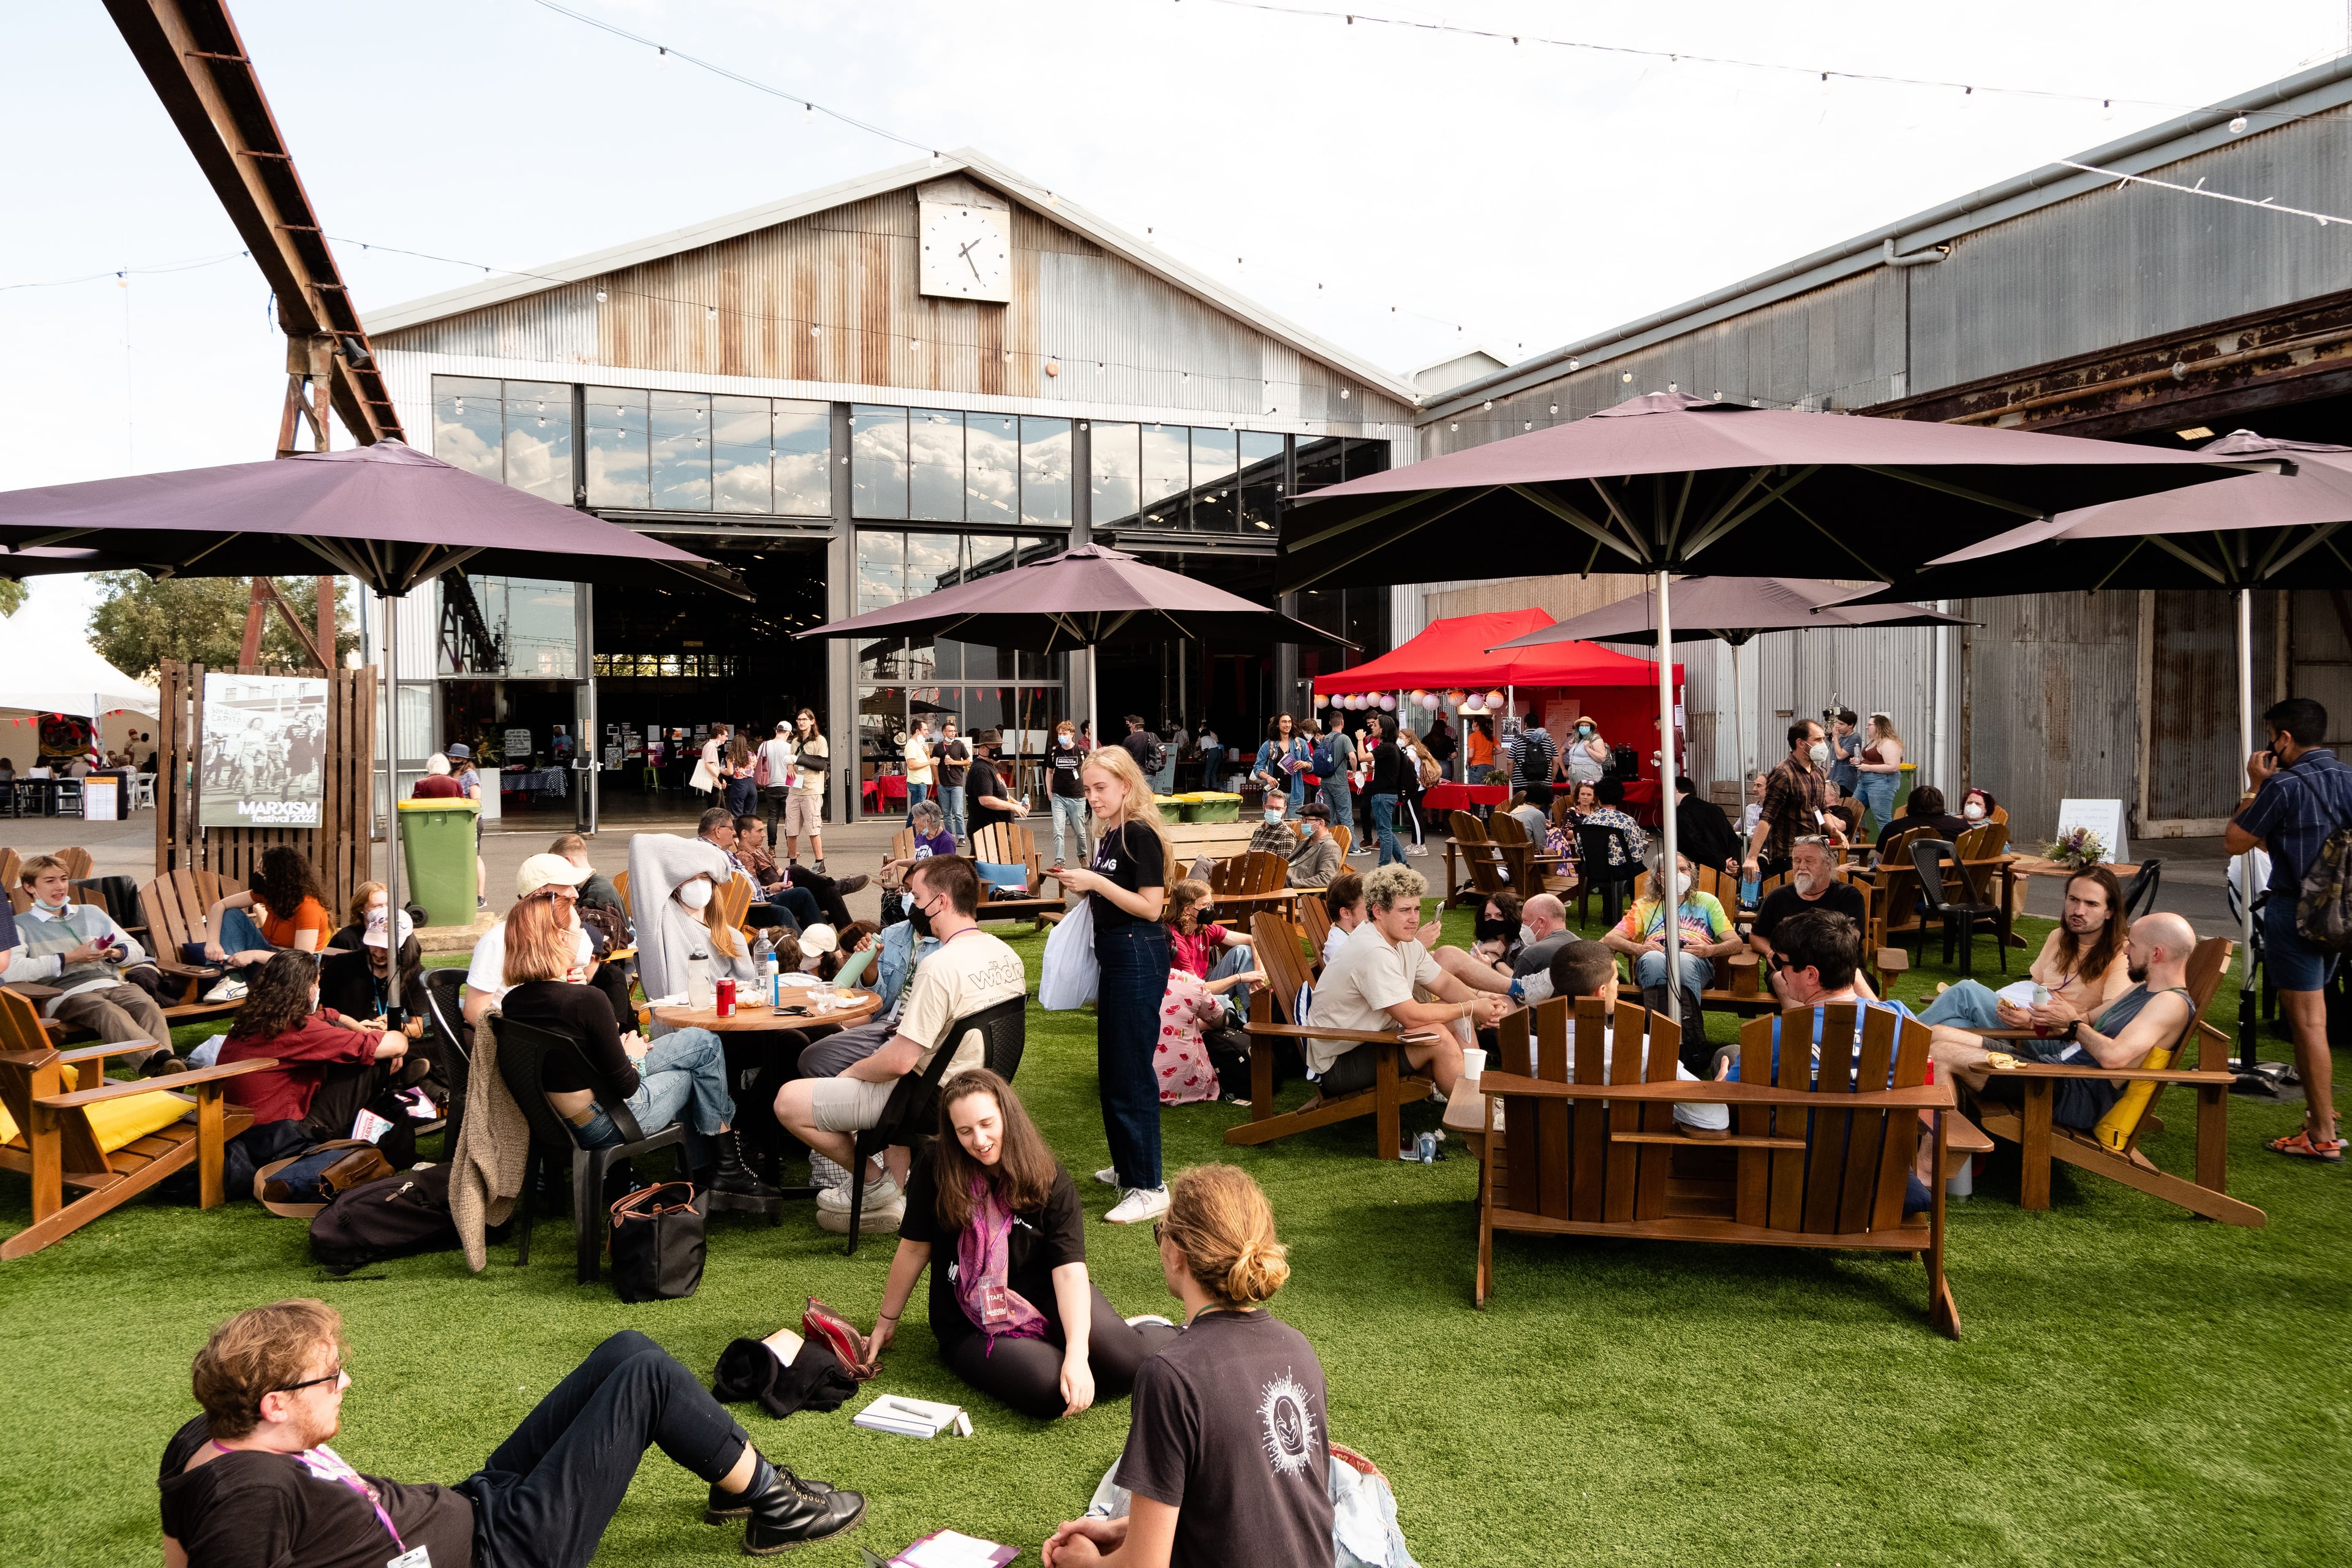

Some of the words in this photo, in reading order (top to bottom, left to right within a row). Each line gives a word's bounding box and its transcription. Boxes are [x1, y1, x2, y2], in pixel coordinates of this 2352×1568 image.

[238, 801, 317, 815] MARXISM
[252, 814, 290, 823] festival
[290, 815, 317, 823] 2022
